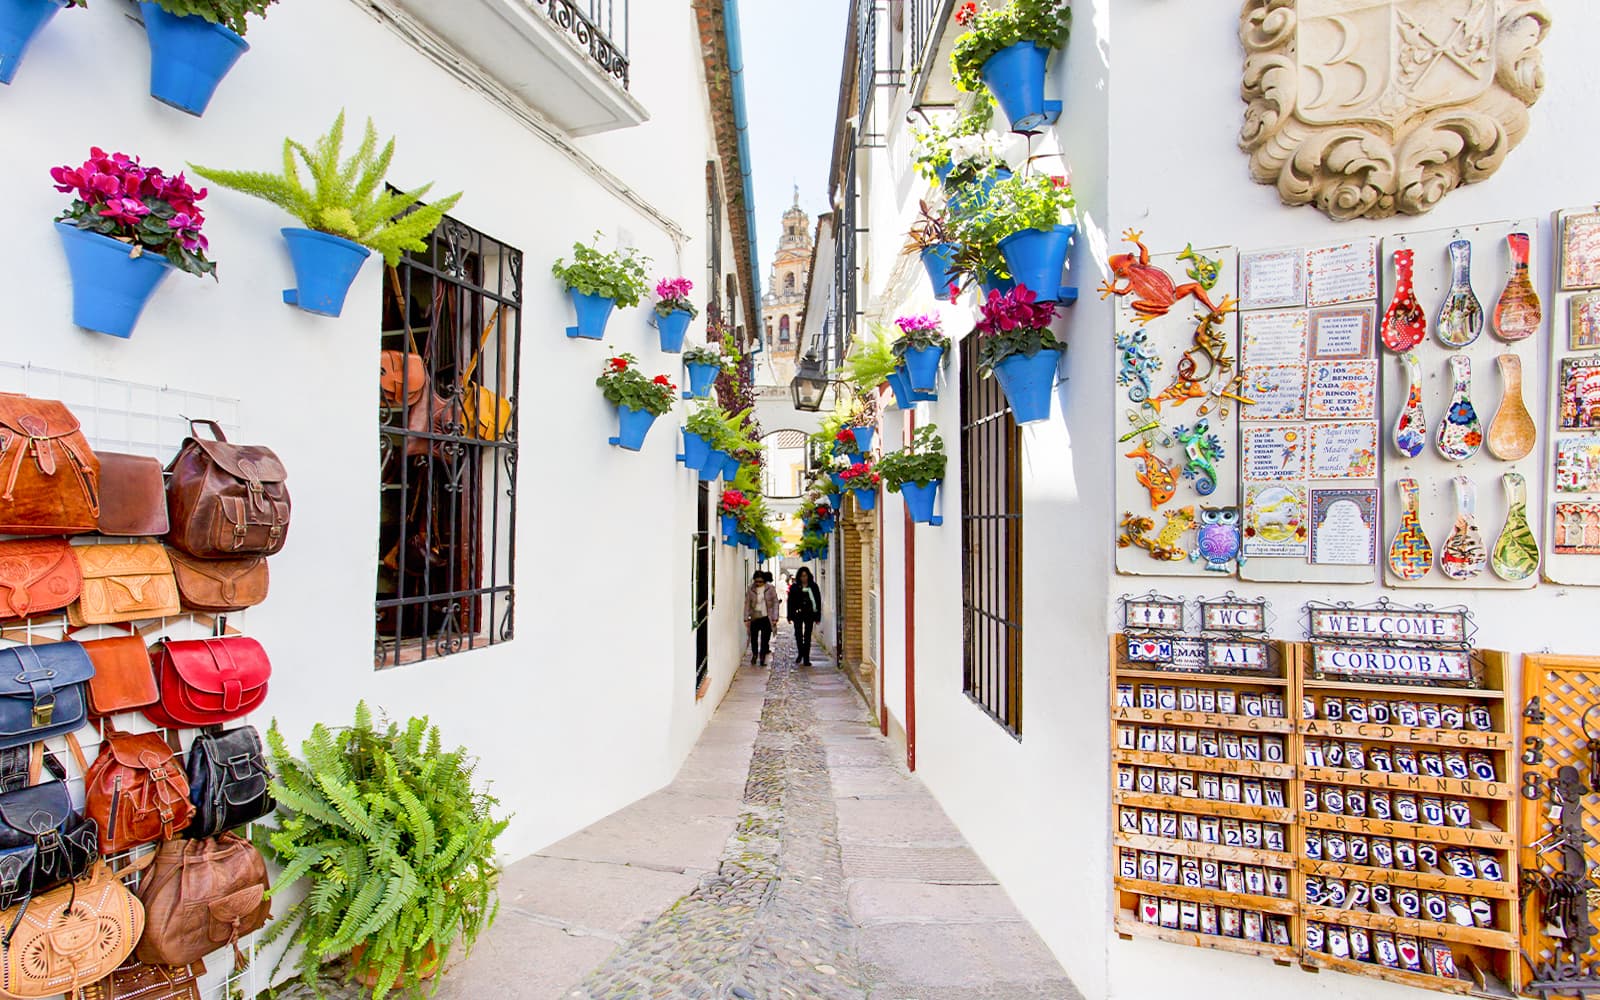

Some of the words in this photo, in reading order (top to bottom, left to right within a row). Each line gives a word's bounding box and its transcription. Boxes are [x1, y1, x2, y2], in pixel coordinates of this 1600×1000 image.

[1220, 610, 1248, 625] WC
[1329, 616, 1445, 635] WELCOME
[1332, 652, 1452, 673] CORDOBA
[1522, 696, 1545, 724] 4
[1521, 771, 1543, 800] 8
